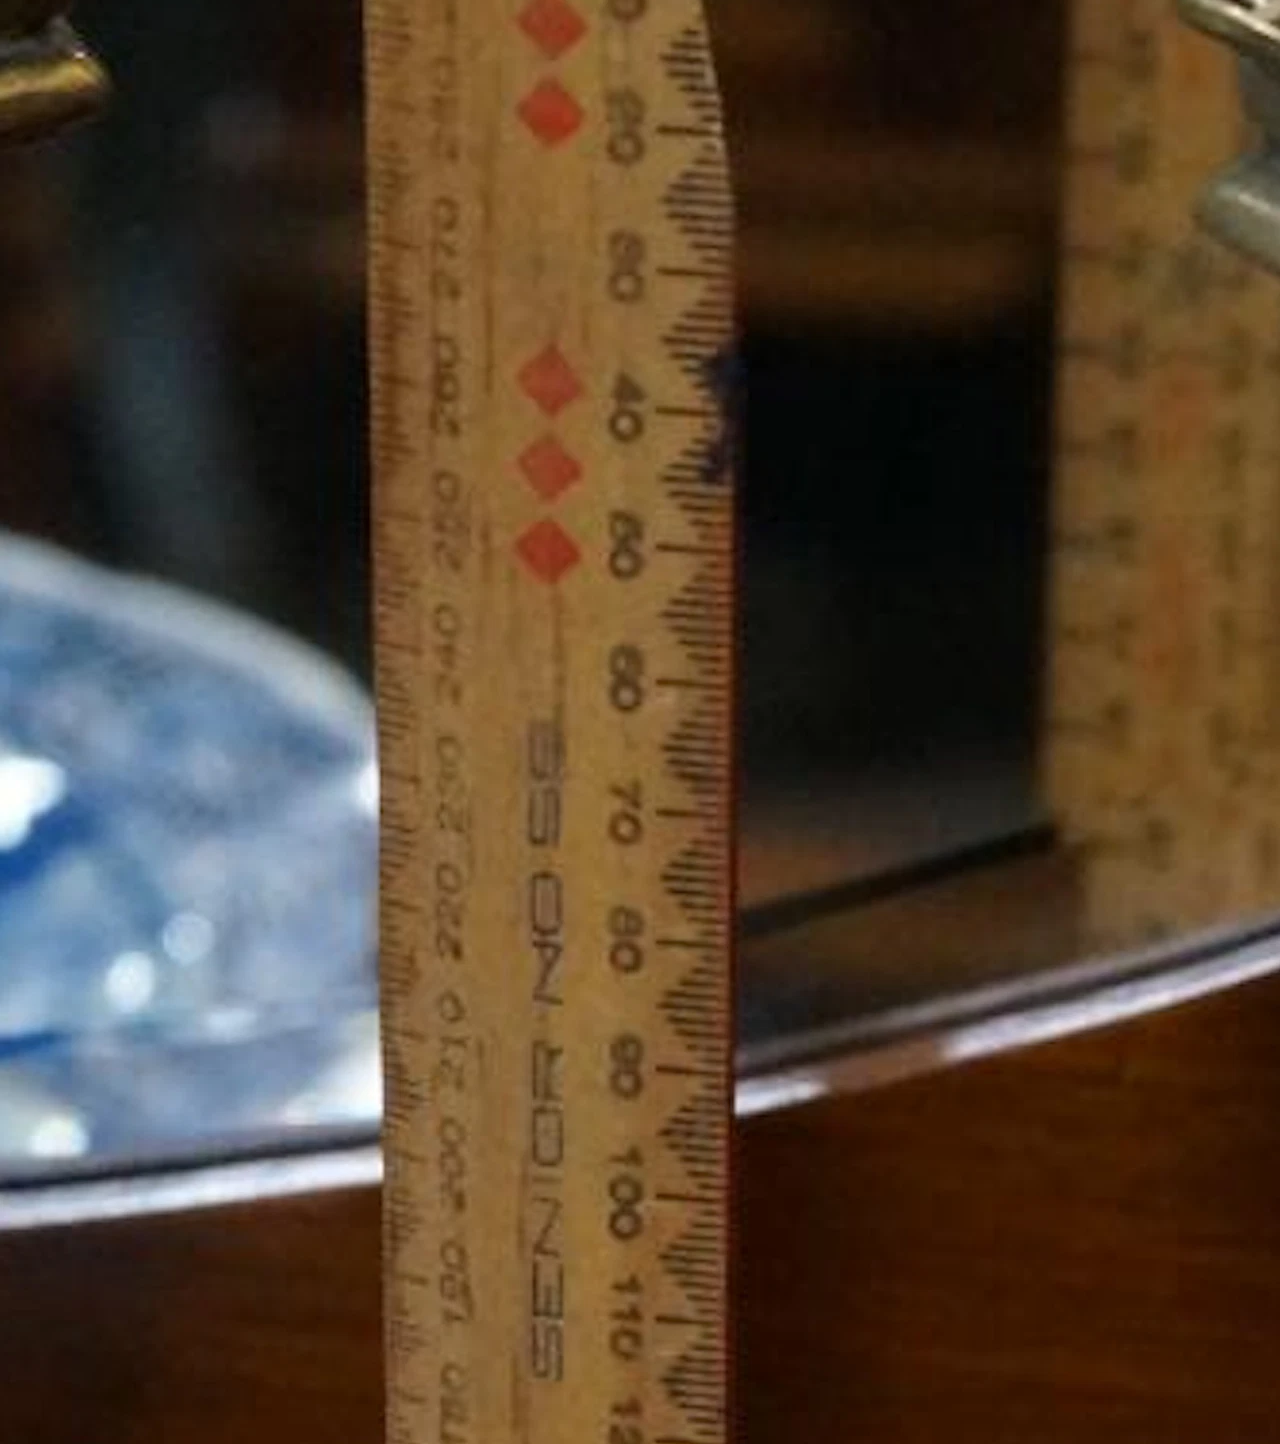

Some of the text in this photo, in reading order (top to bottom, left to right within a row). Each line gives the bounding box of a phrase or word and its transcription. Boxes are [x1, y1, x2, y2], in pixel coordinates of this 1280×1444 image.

[432, 335, 461, 438] 260
[608, 370, 645, 443] 40
[434, 602, 462, 705] 240
[608, 644, 645, 713] 60
[608, 778, 645, 846] 70
[435, 862, 462, 962] 220
[608, 906, 645, 974] 80
[436, 992, 466, 1093] 210
[608, 1033, 645, 1100] 90
[438, 1117, 467, 1213] 200
[531, 1039, 564, 1382] SENIOR
[608, 1146, 645, 1240] 100
[608, 1272, 645, 1361] 110
